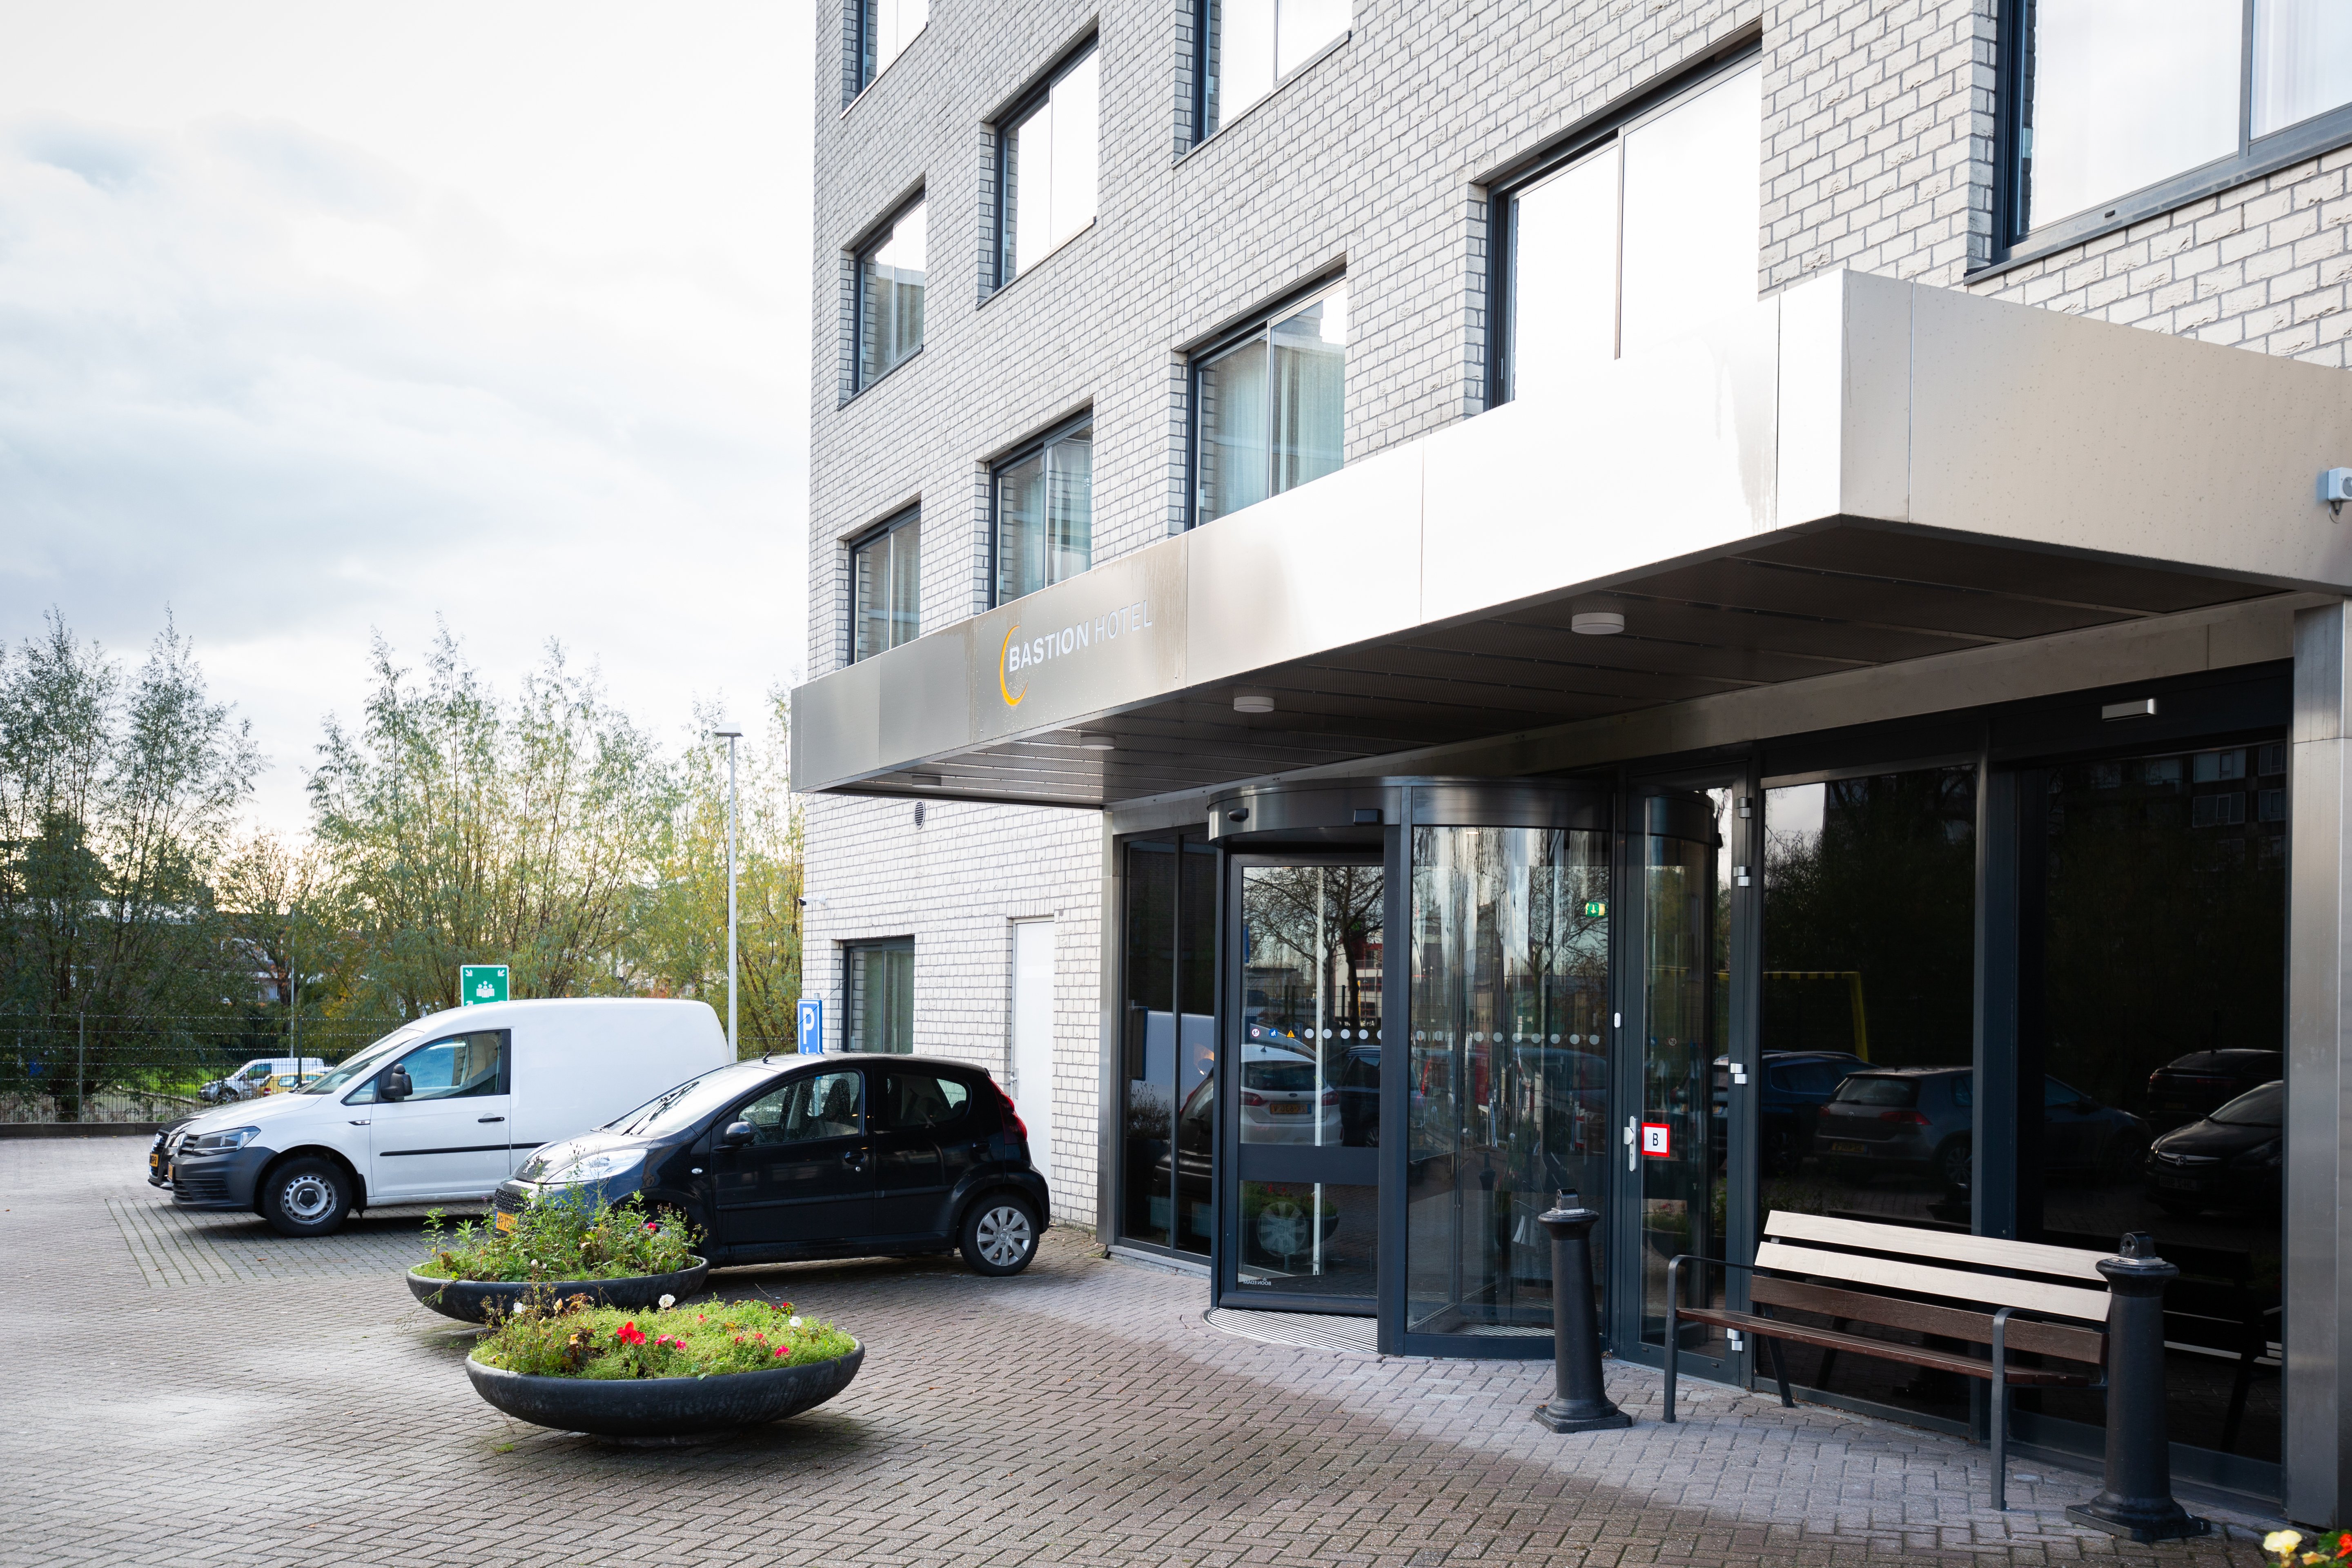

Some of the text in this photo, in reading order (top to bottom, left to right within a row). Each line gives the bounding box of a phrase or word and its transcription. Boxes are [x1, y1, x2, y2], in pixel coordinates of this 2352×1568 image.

[1009, 600, 1152, 672] BASTION HOTEL
[803, 1007, 815, 1044] P
[1653, 1133, 1658, 1146] B
